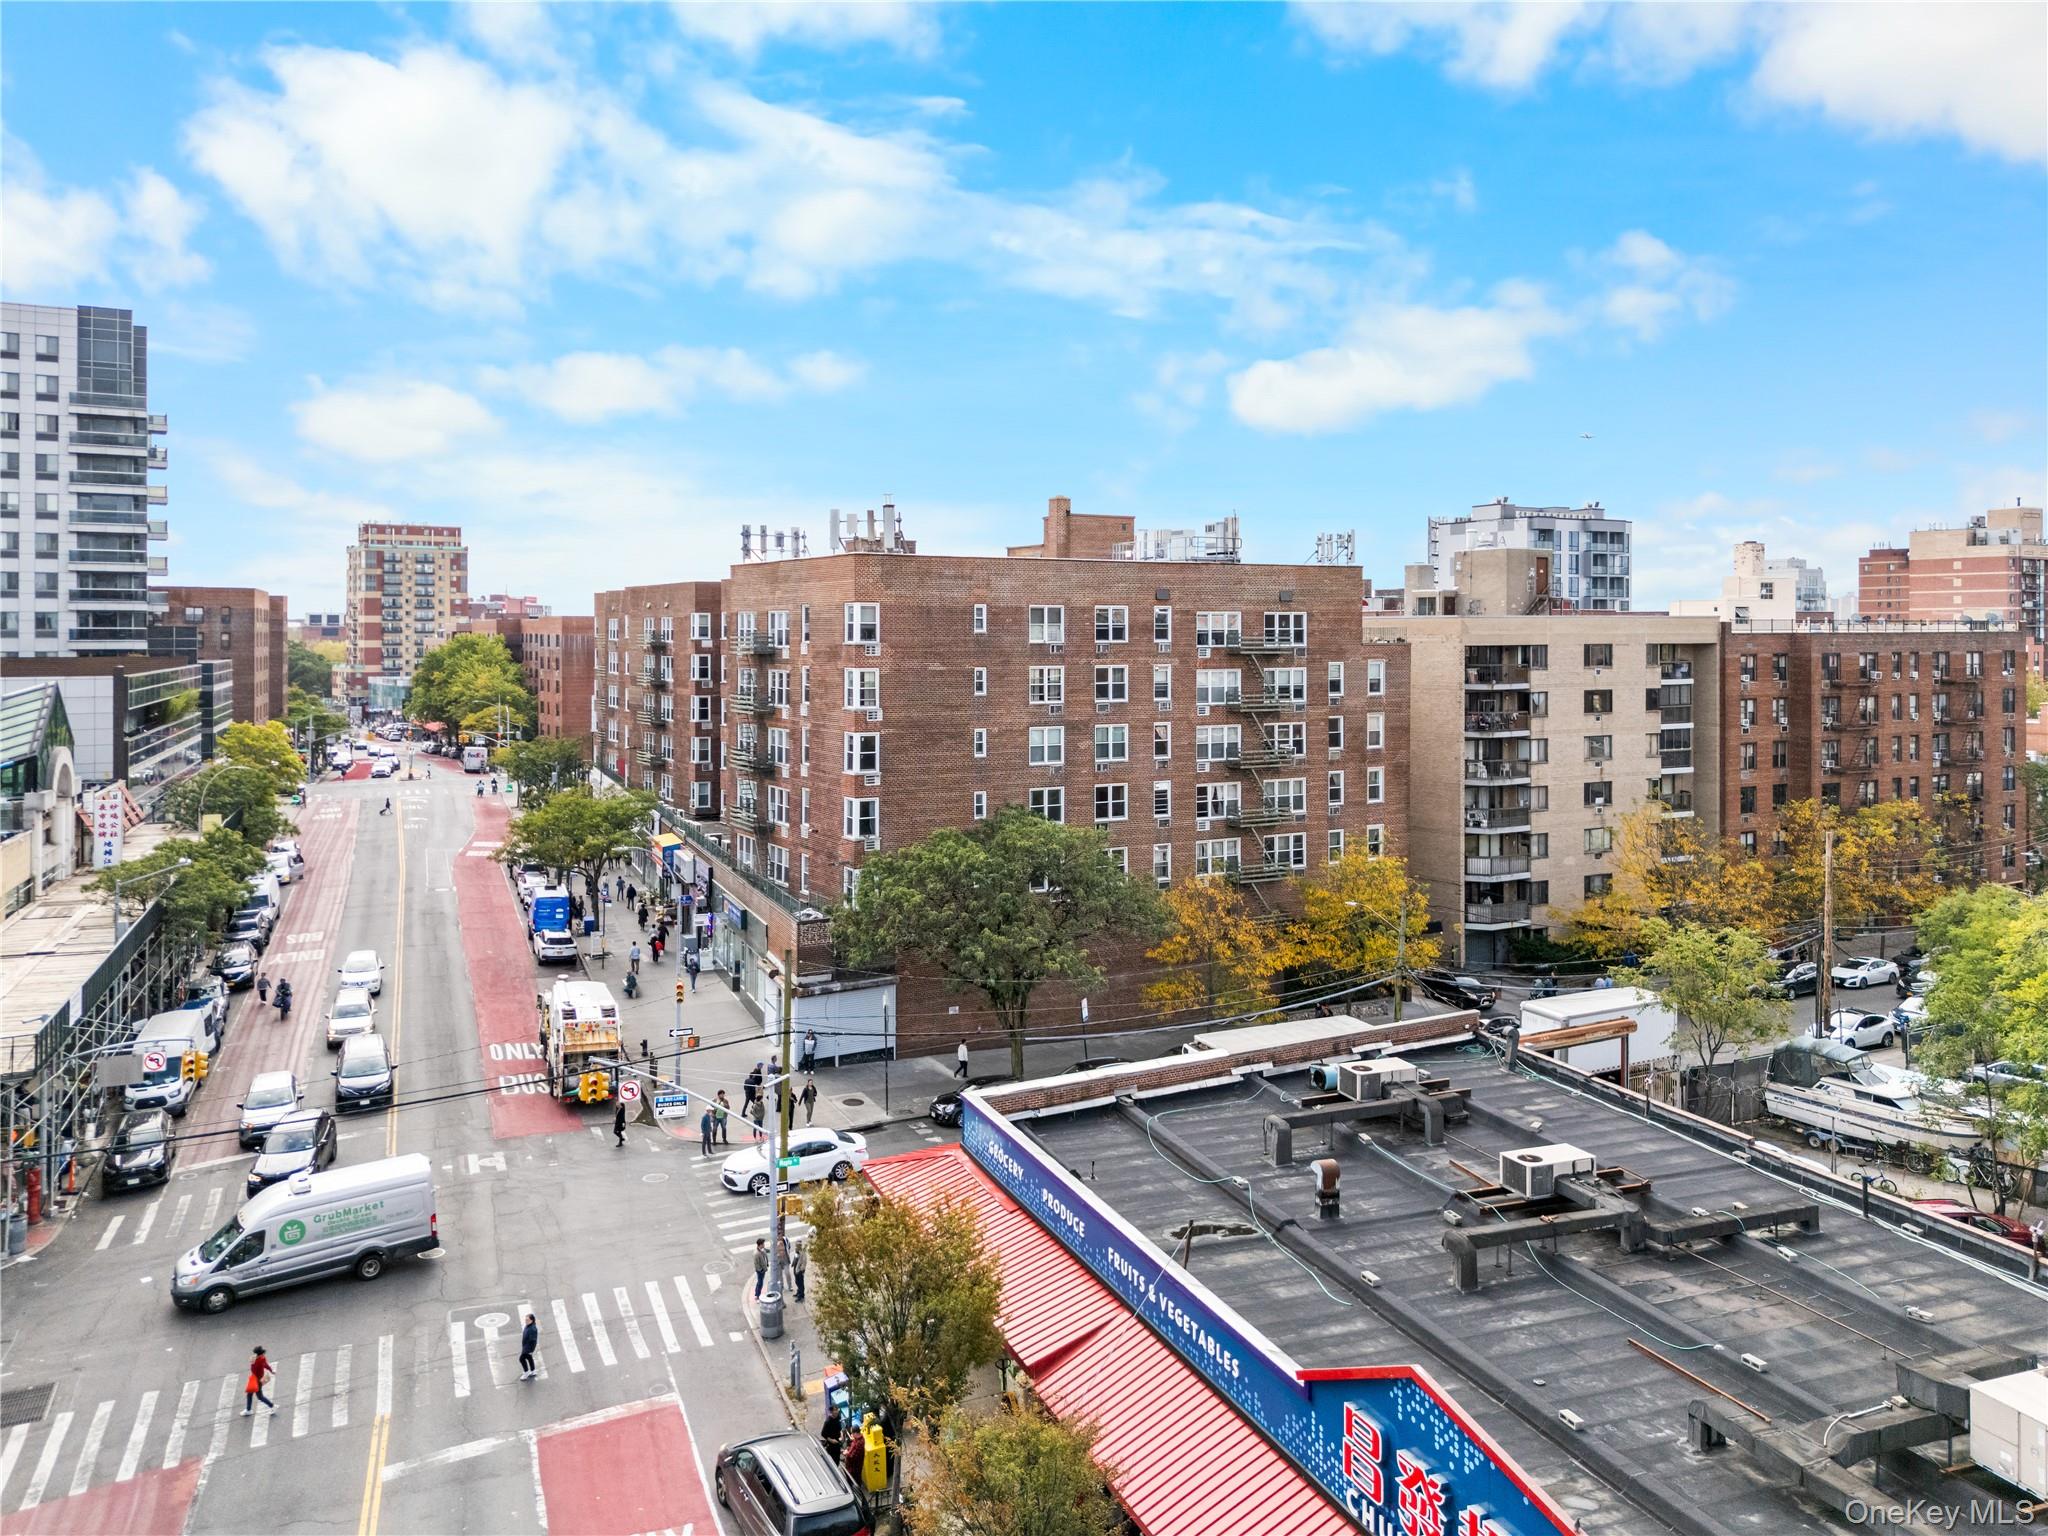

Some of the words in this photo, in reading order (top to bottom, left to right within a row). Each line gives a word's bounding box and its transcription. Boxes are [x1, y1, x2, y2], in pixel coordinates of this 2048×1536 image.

[490, 1042, 545, 1061] ONLY
[499, 1073, 551, 1096] BUS
[988, 1140, 1025, 1181] GROCERY
[313, 1200, 385, 1223] GrubMarket
[1042, 1188, 1085, 1238] PRODUCE
[1107, 1247, 1146, 1293] FRUITS
[1148, 1284, 1157, 1302] &
[1159, 1292, 1240, 1378] VEGETABLES
